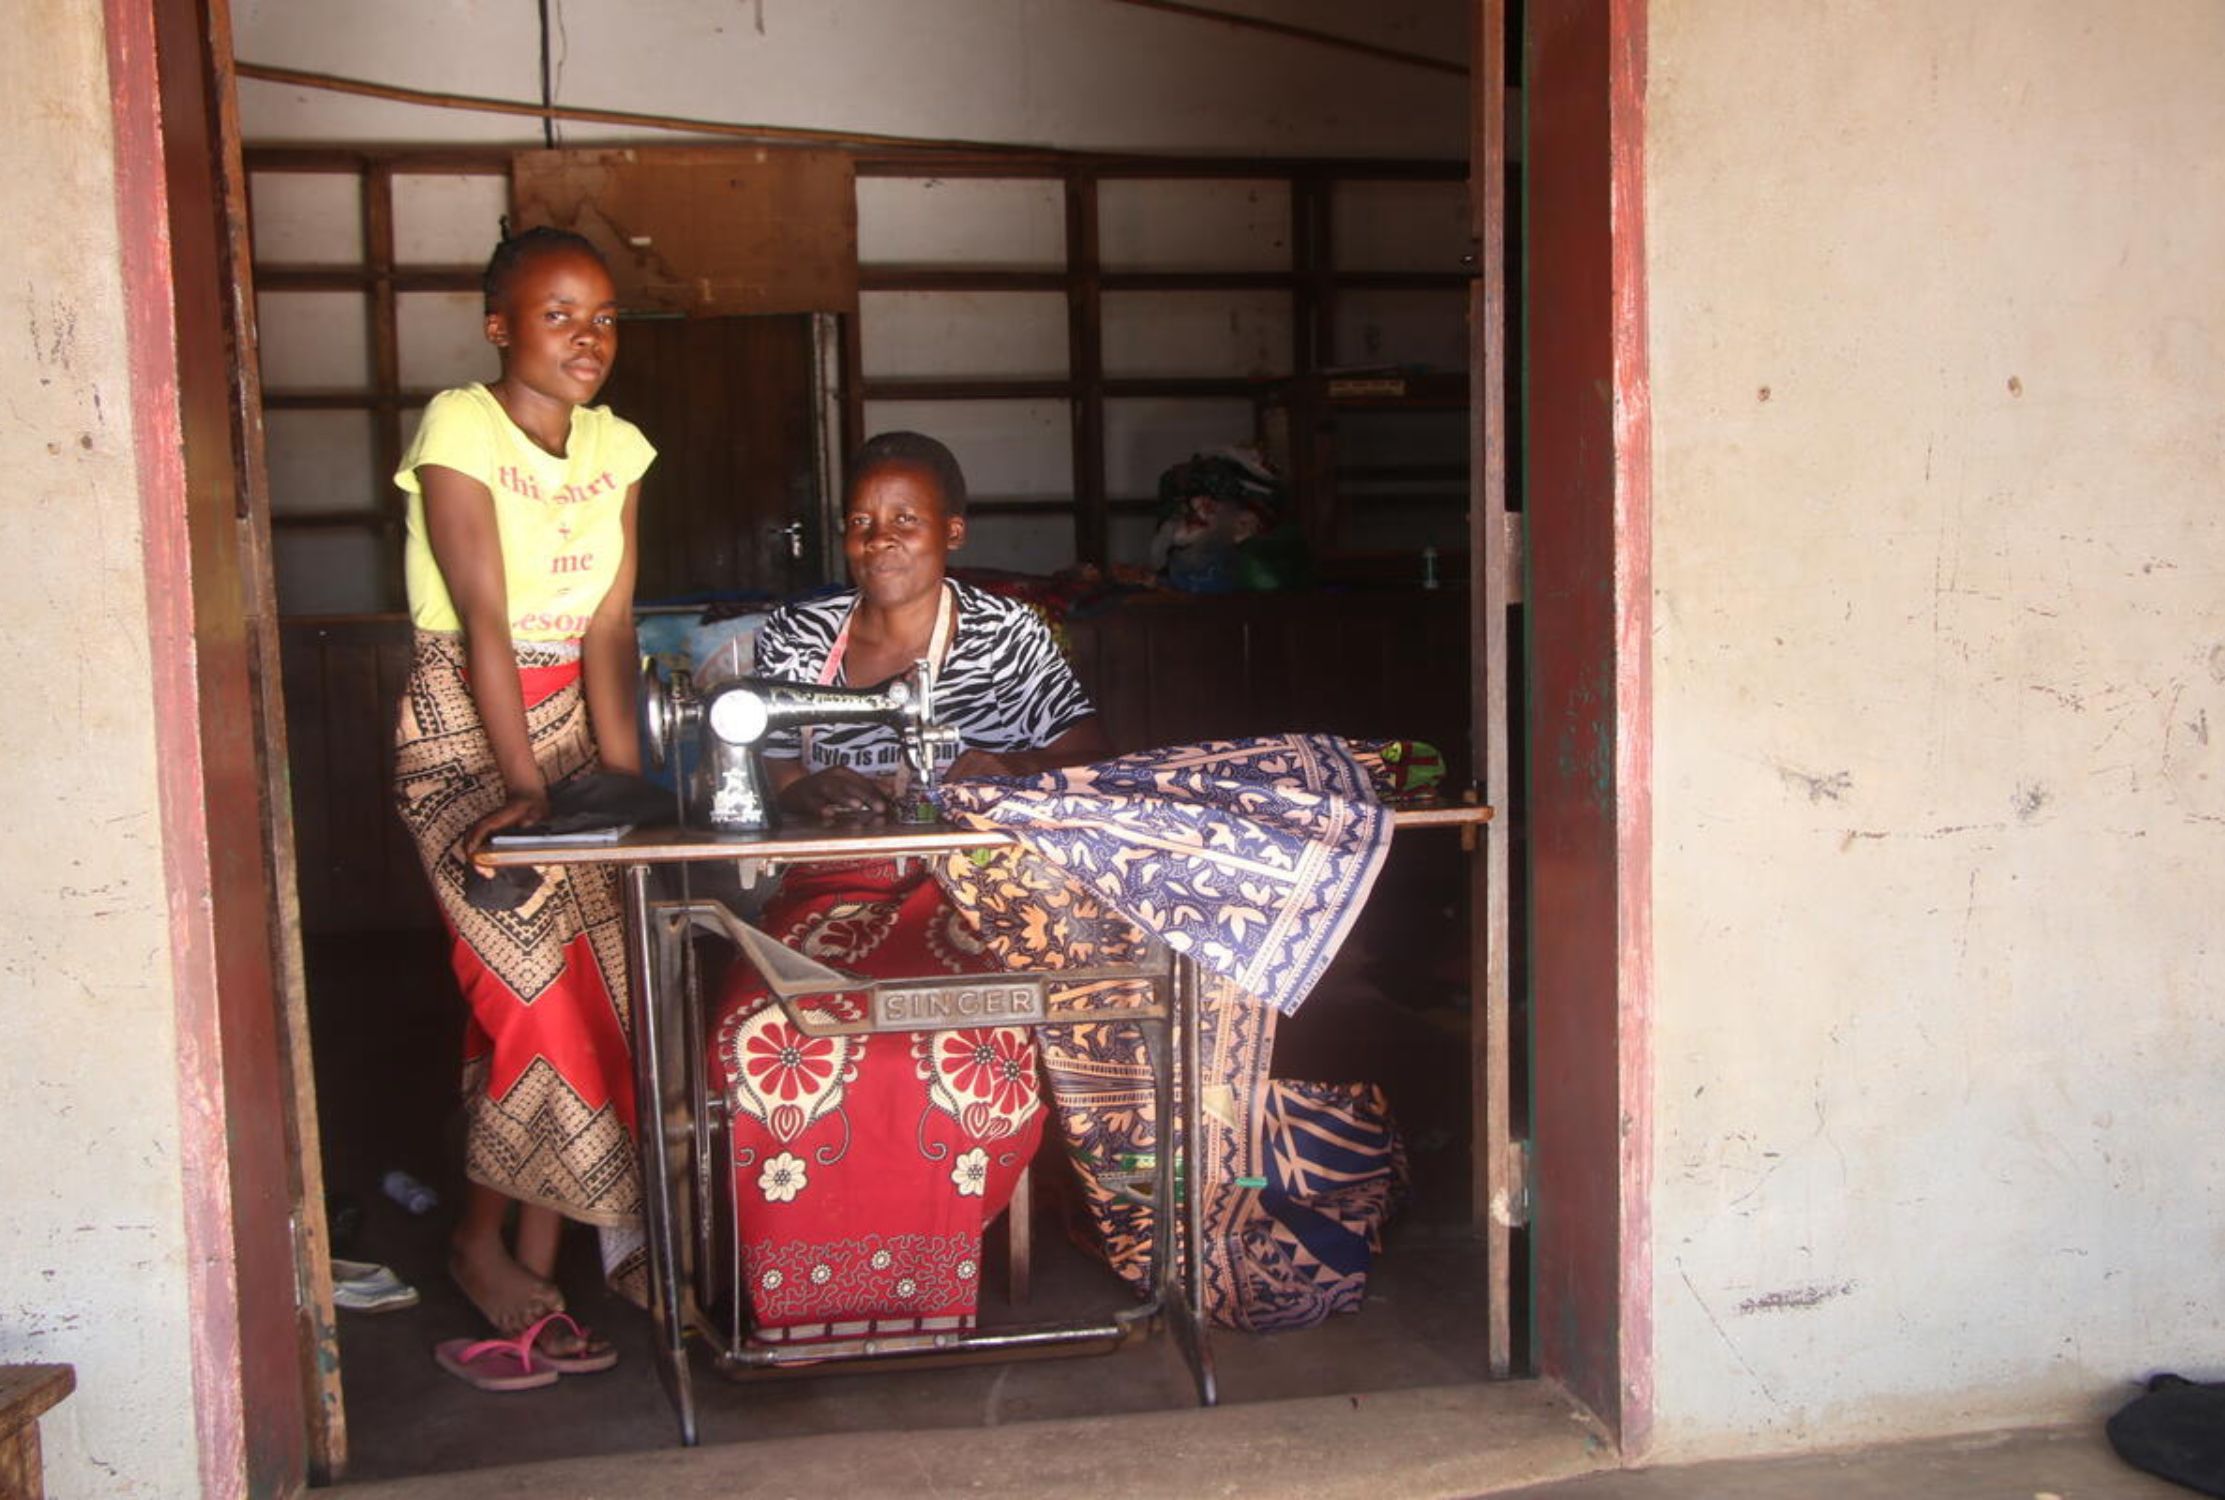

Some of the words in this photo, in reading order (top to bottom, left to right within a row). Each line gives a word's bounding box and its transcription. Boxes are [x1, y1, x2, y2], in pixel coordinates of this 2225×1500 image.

[498, 466, 548, 504] thi
[553, 471, 617, 504] shrt
[551, 552, 594, 575] me
[855, 749, 872, 766] is
[885, 987, 1035, 1021] SINGER
